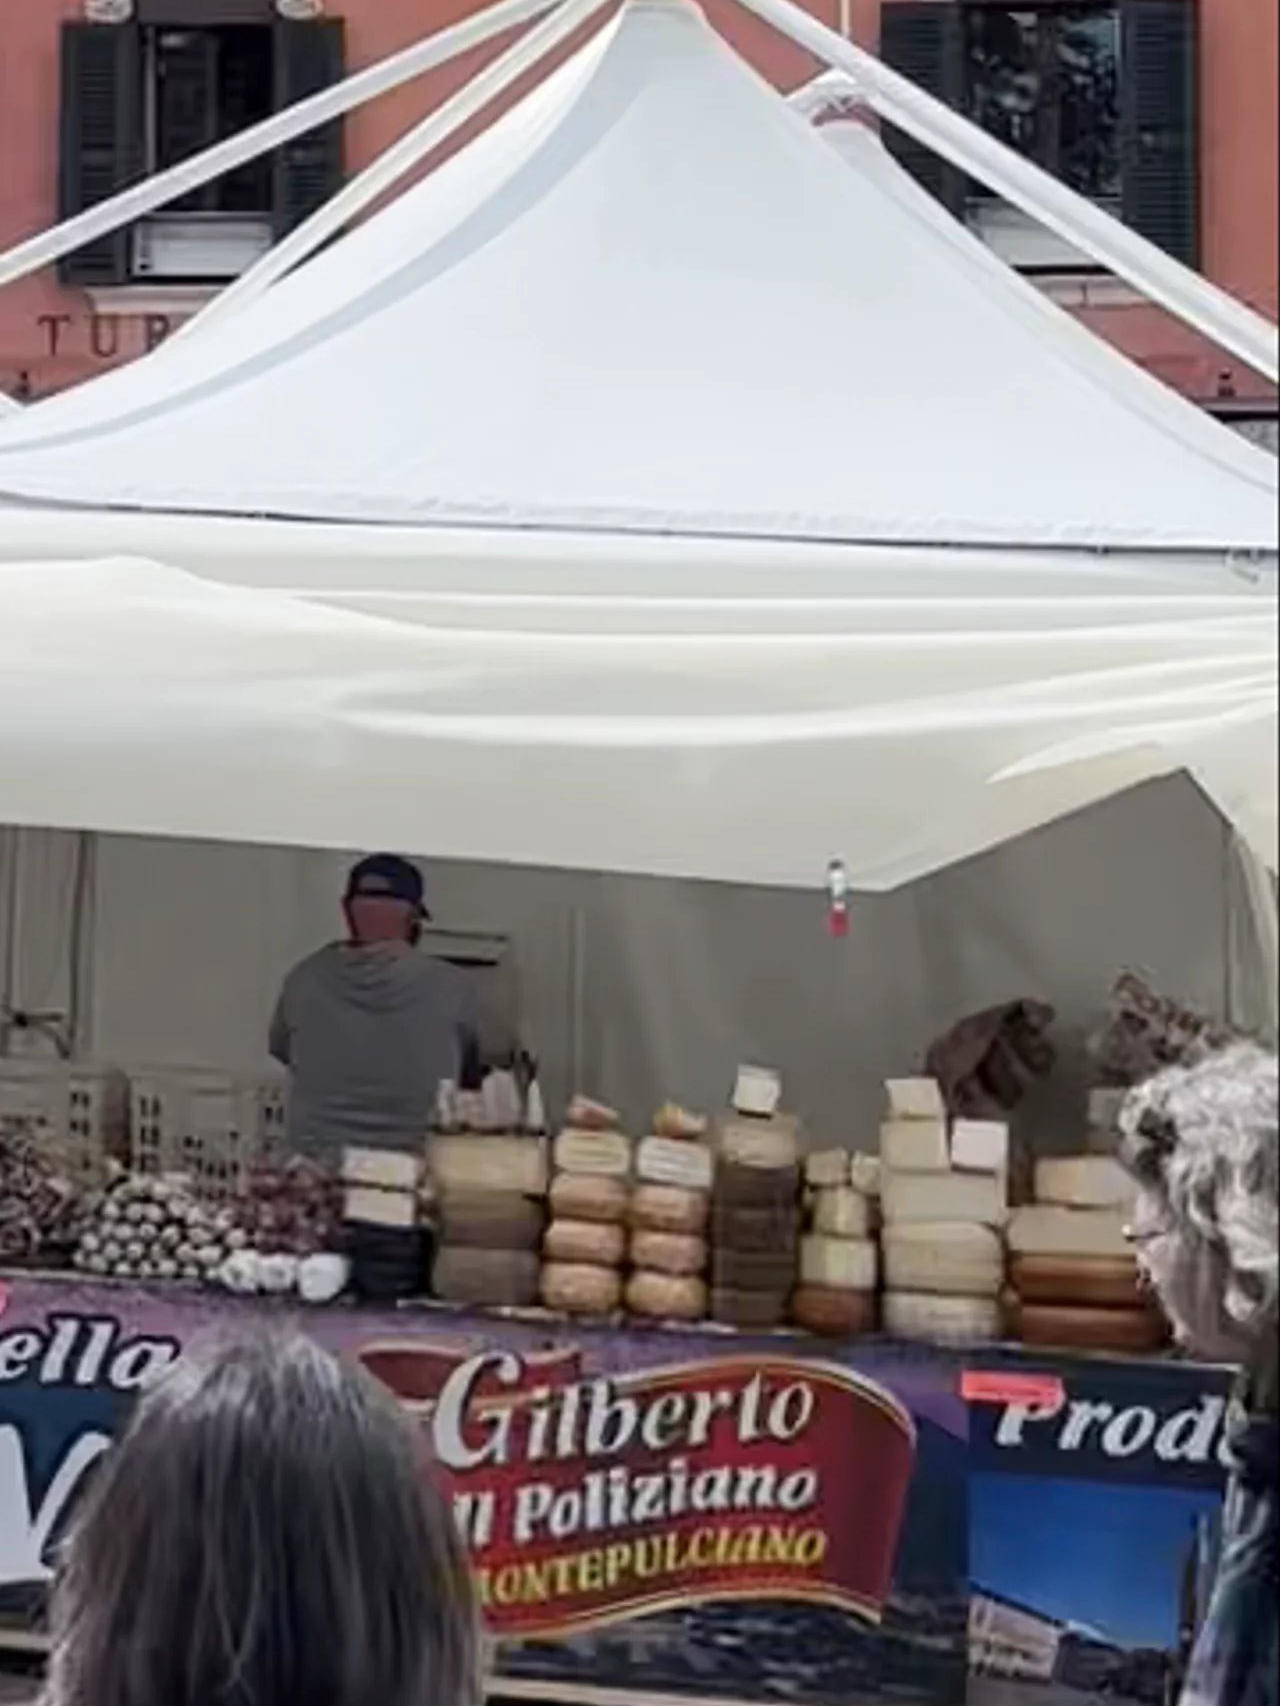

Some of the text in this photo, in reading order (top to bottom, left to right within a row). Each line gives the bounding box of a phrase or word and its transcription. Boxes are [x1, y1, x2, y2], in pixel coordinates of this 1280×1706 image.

[37, 314, 170, 358] TUR
[431, 1351, 815, 1469] Gilberto
[996, 1393, 1238, 1468] Prod
[513, 1455, 818, 1544] Poliziano
